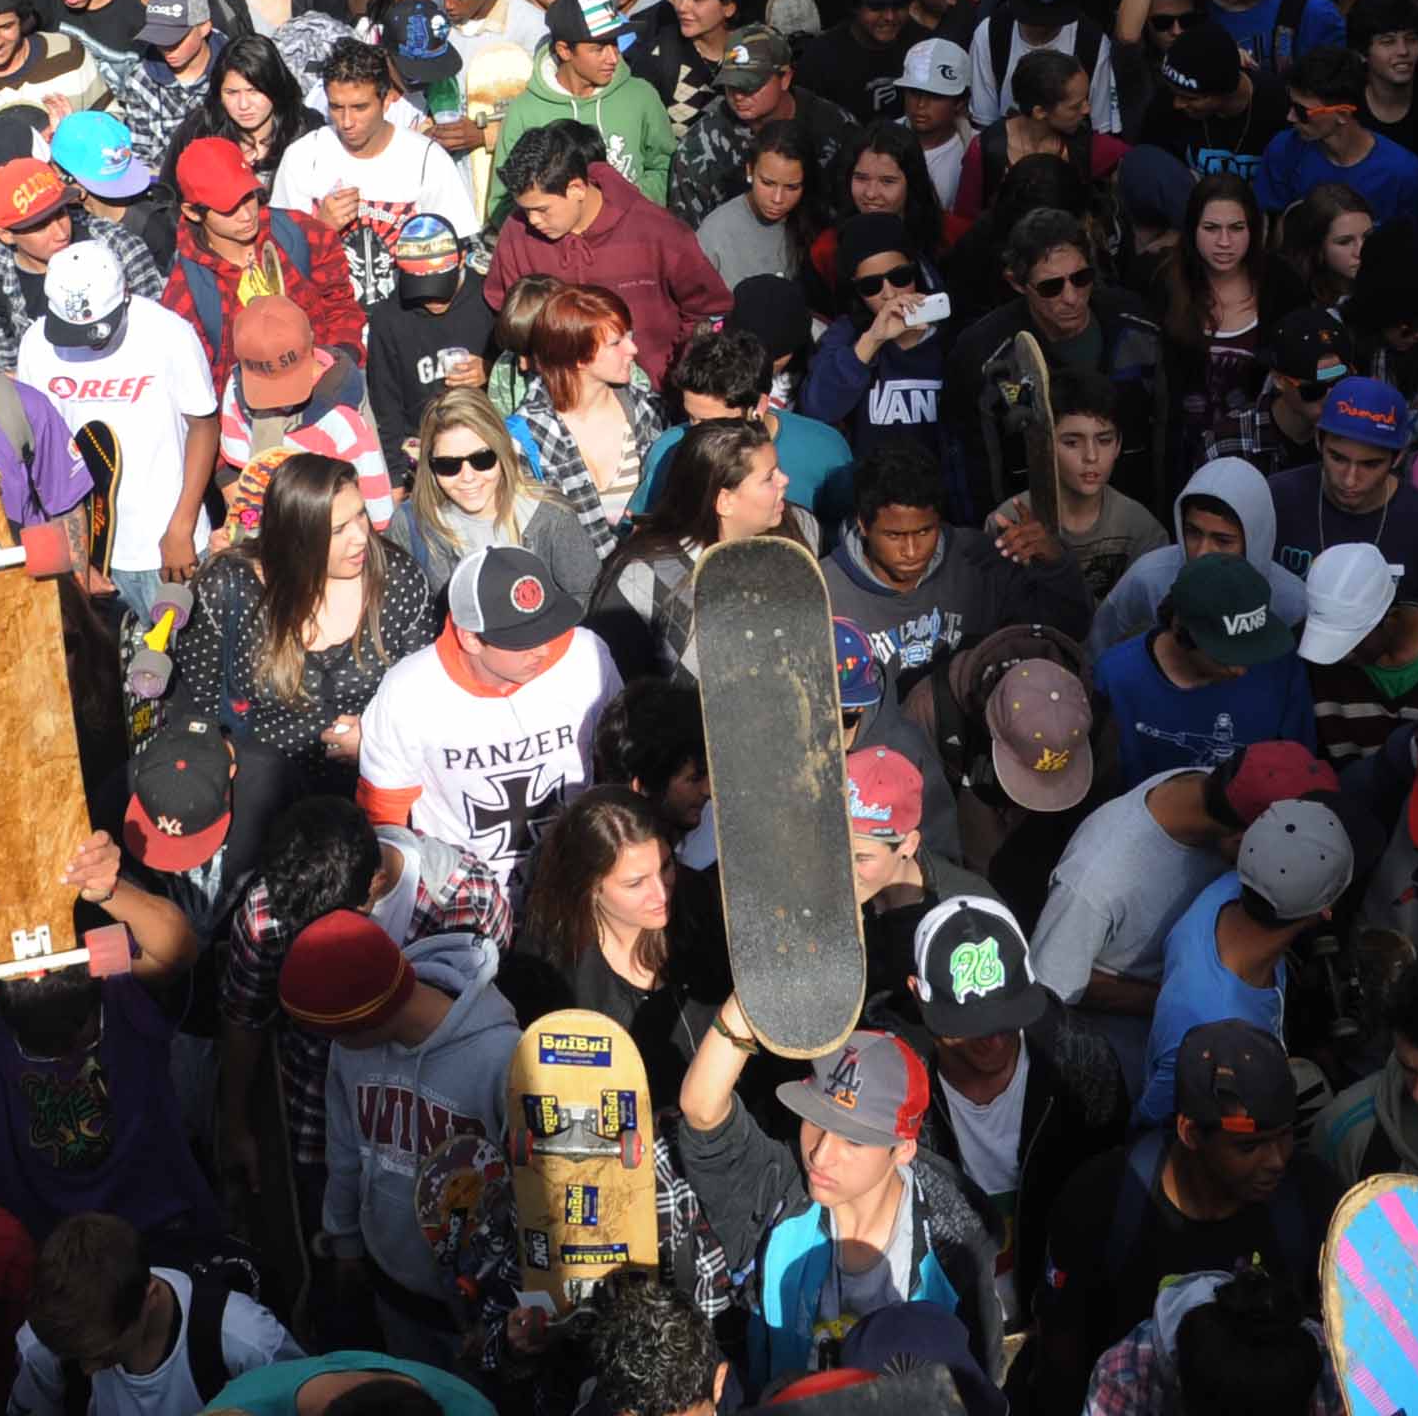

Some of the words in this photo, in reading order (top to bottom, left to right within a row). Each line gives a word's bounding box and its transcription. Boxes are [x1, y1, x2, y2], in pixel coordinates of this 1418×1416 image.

[78, 375, 156, 403] REEF
[1337, 397, 1397, 426] Diamond
[1222, 604, 1268, 636] VANS
[444, 722, 575, 772] PANZER
[542, 1034, 611, 1053] BuiBui
